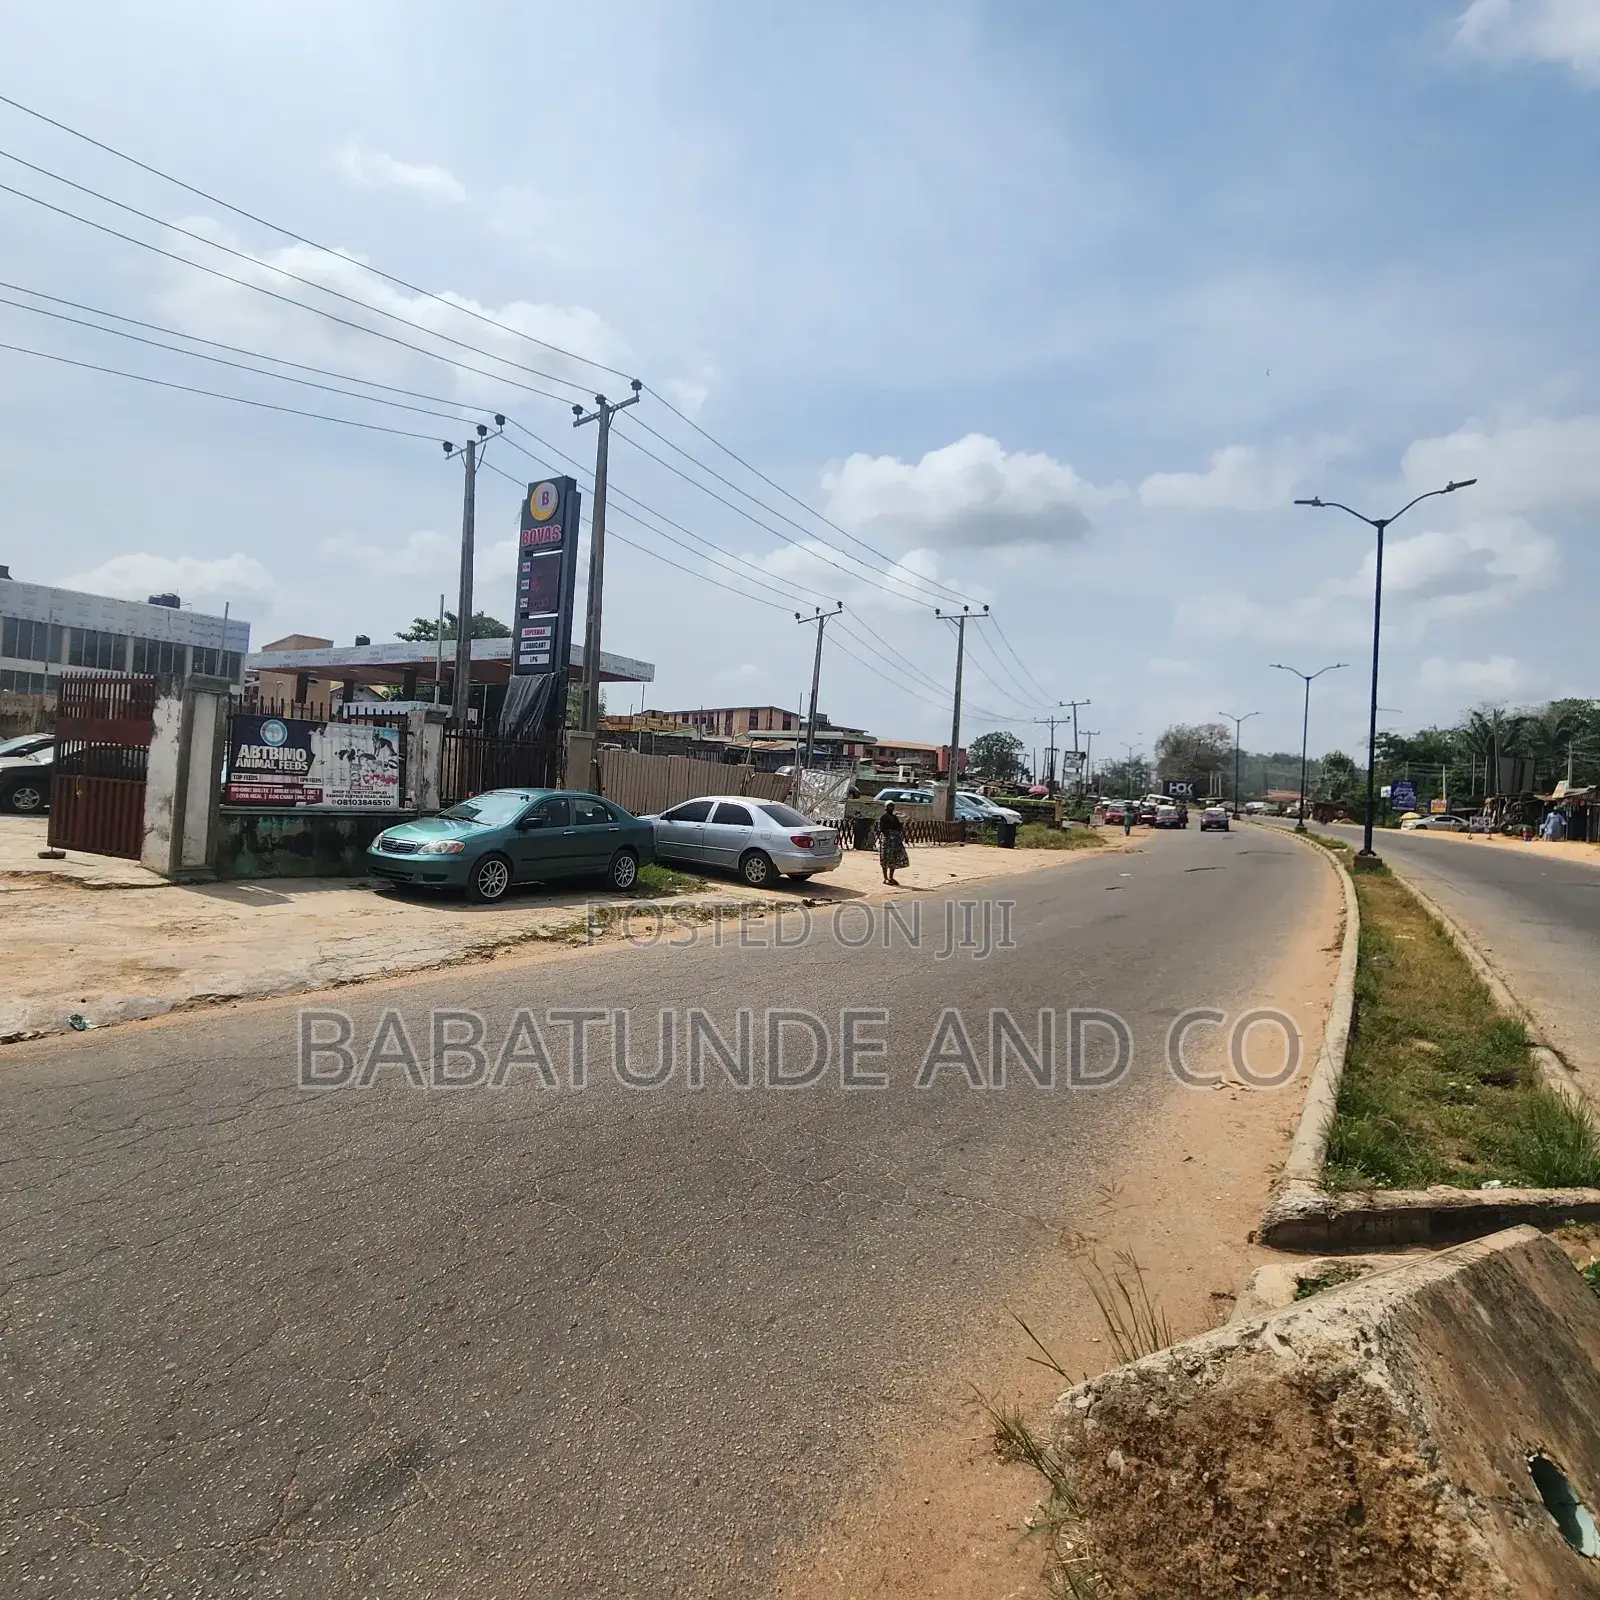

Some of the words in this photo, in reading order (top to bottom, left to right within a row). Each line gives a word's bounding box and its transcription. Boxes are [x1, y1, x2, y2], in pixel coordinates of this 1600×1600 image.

[542, 490, 550, 507] B
[521, 525, 561, 545] BOVAS
[523, 641, 547, 650] LUBRICANT
[237, 744, 307, 762] ABTBIMO
[234, 757, 277, 769] ANIMAL
[278, 760, 309, 771] FEEDS
